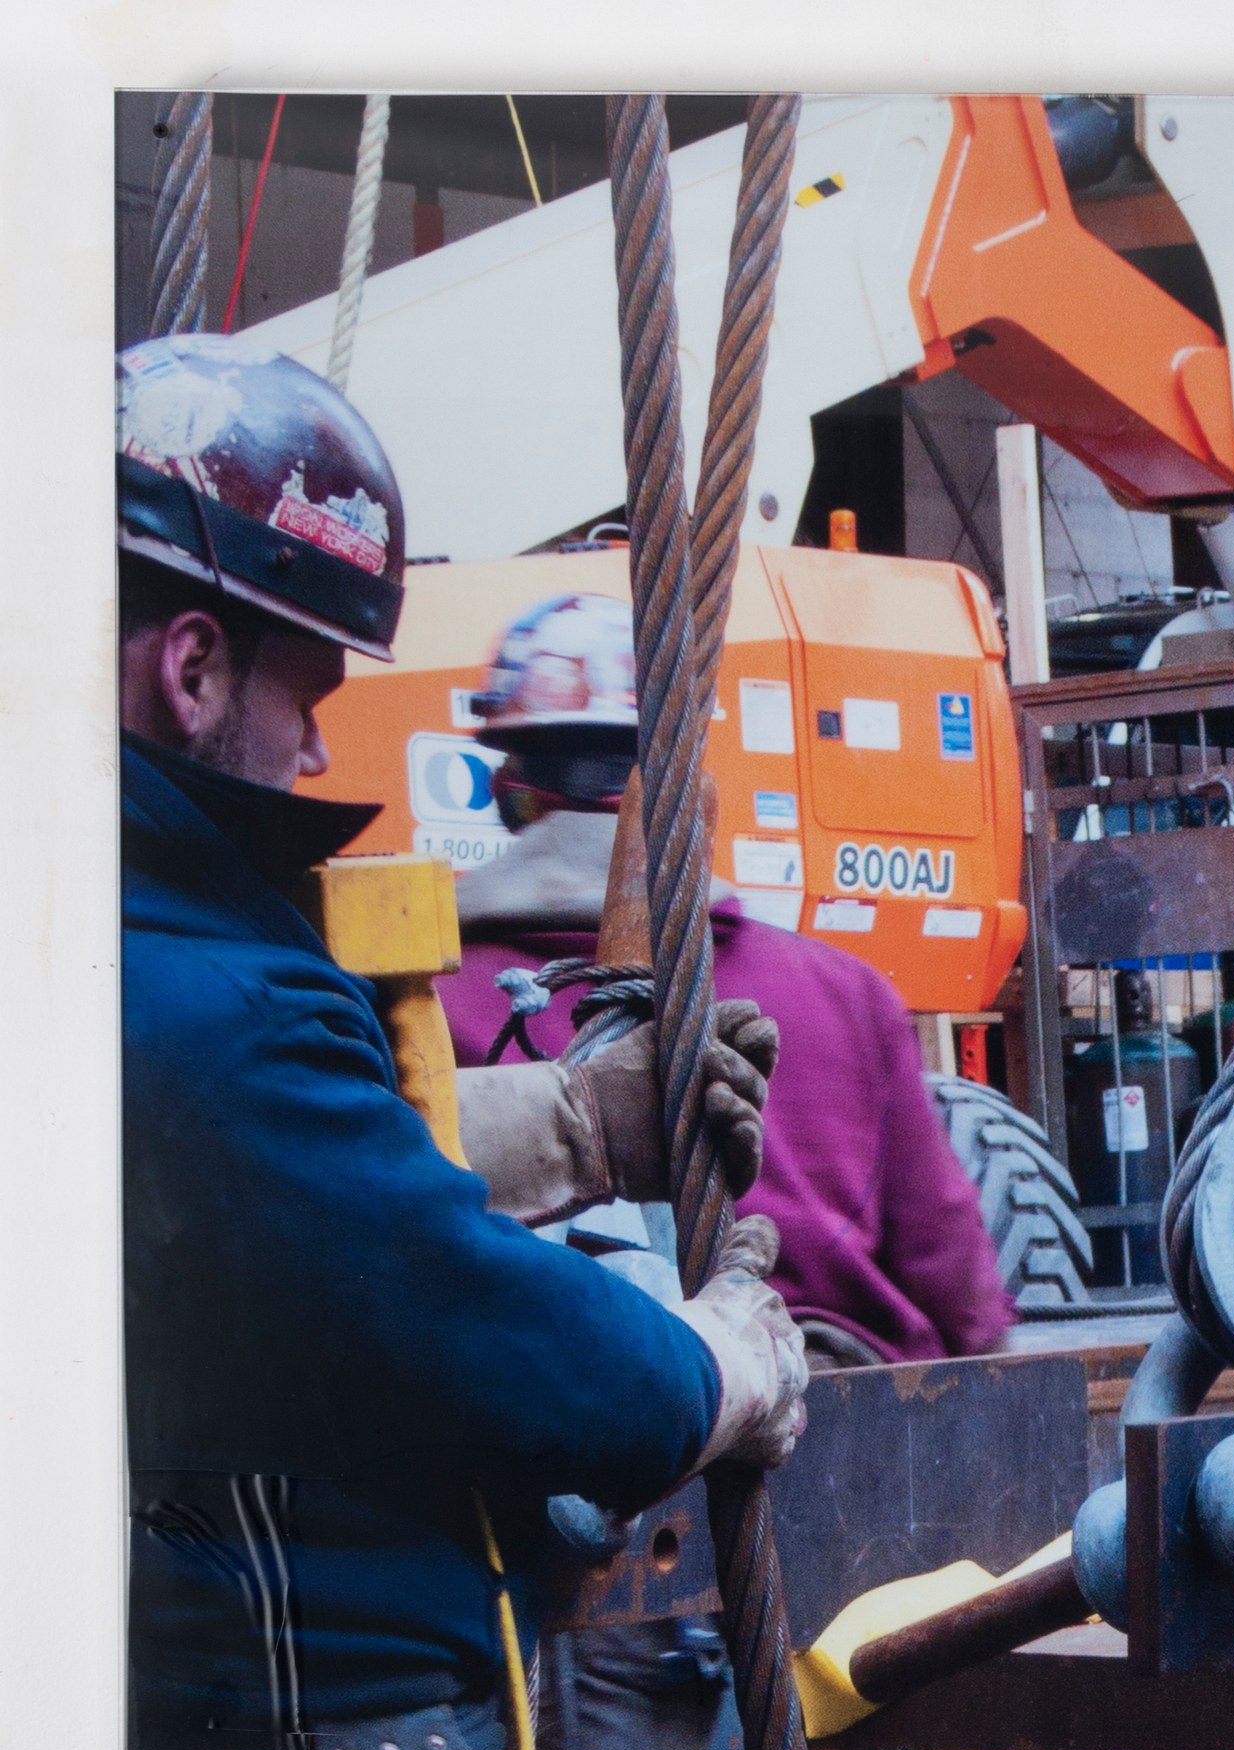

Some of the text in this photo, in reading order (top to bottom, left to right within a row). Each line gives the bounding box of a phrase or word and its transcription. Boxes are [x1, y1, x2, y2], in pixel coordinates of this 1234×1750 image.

[281, 512, 319, 538] NEW
[320, 533, 355, 558] YORK
[837, 844, 954, 895] 800AJ
